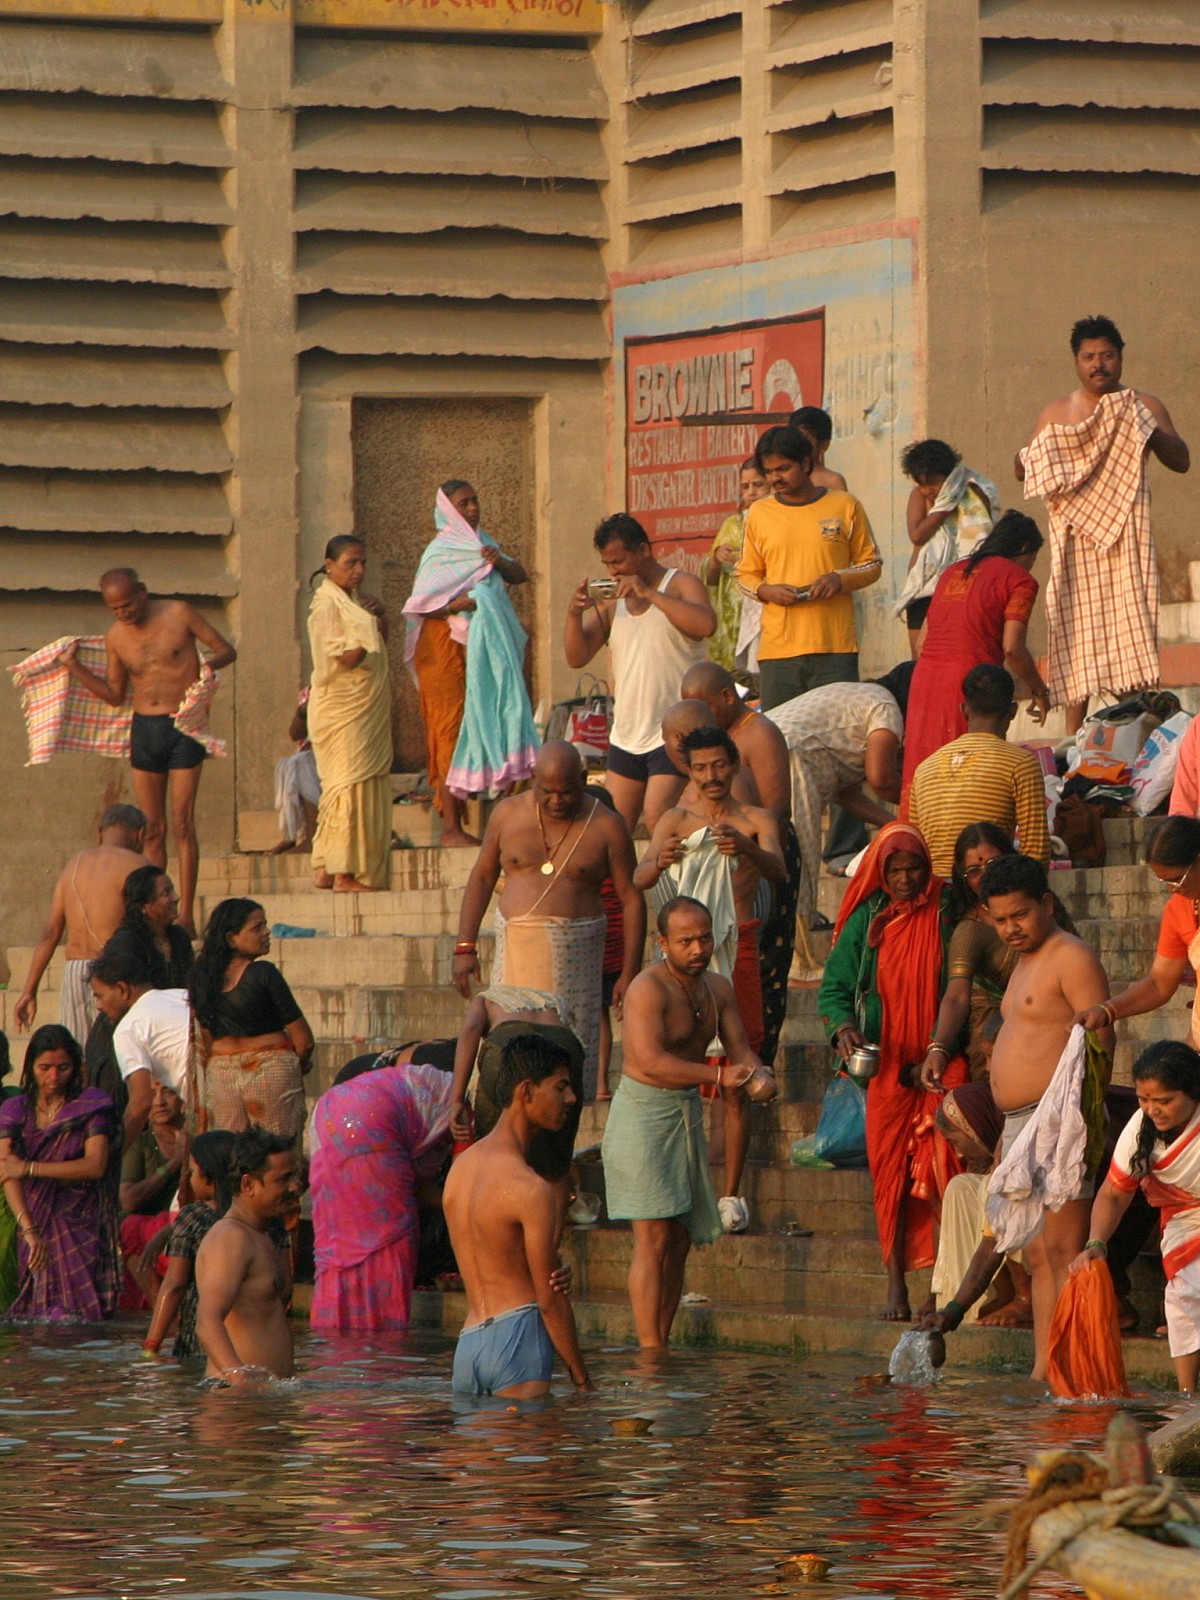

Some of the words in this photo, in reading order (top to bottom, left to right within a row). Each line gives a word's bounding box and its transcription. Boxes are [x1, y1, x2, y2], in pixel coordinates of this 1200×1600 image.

[634, 348, 755, 424] BROWNIE
[629, 426, 705, 466] RESTAURANT
[707, 424, 758, 458] BAKERY
